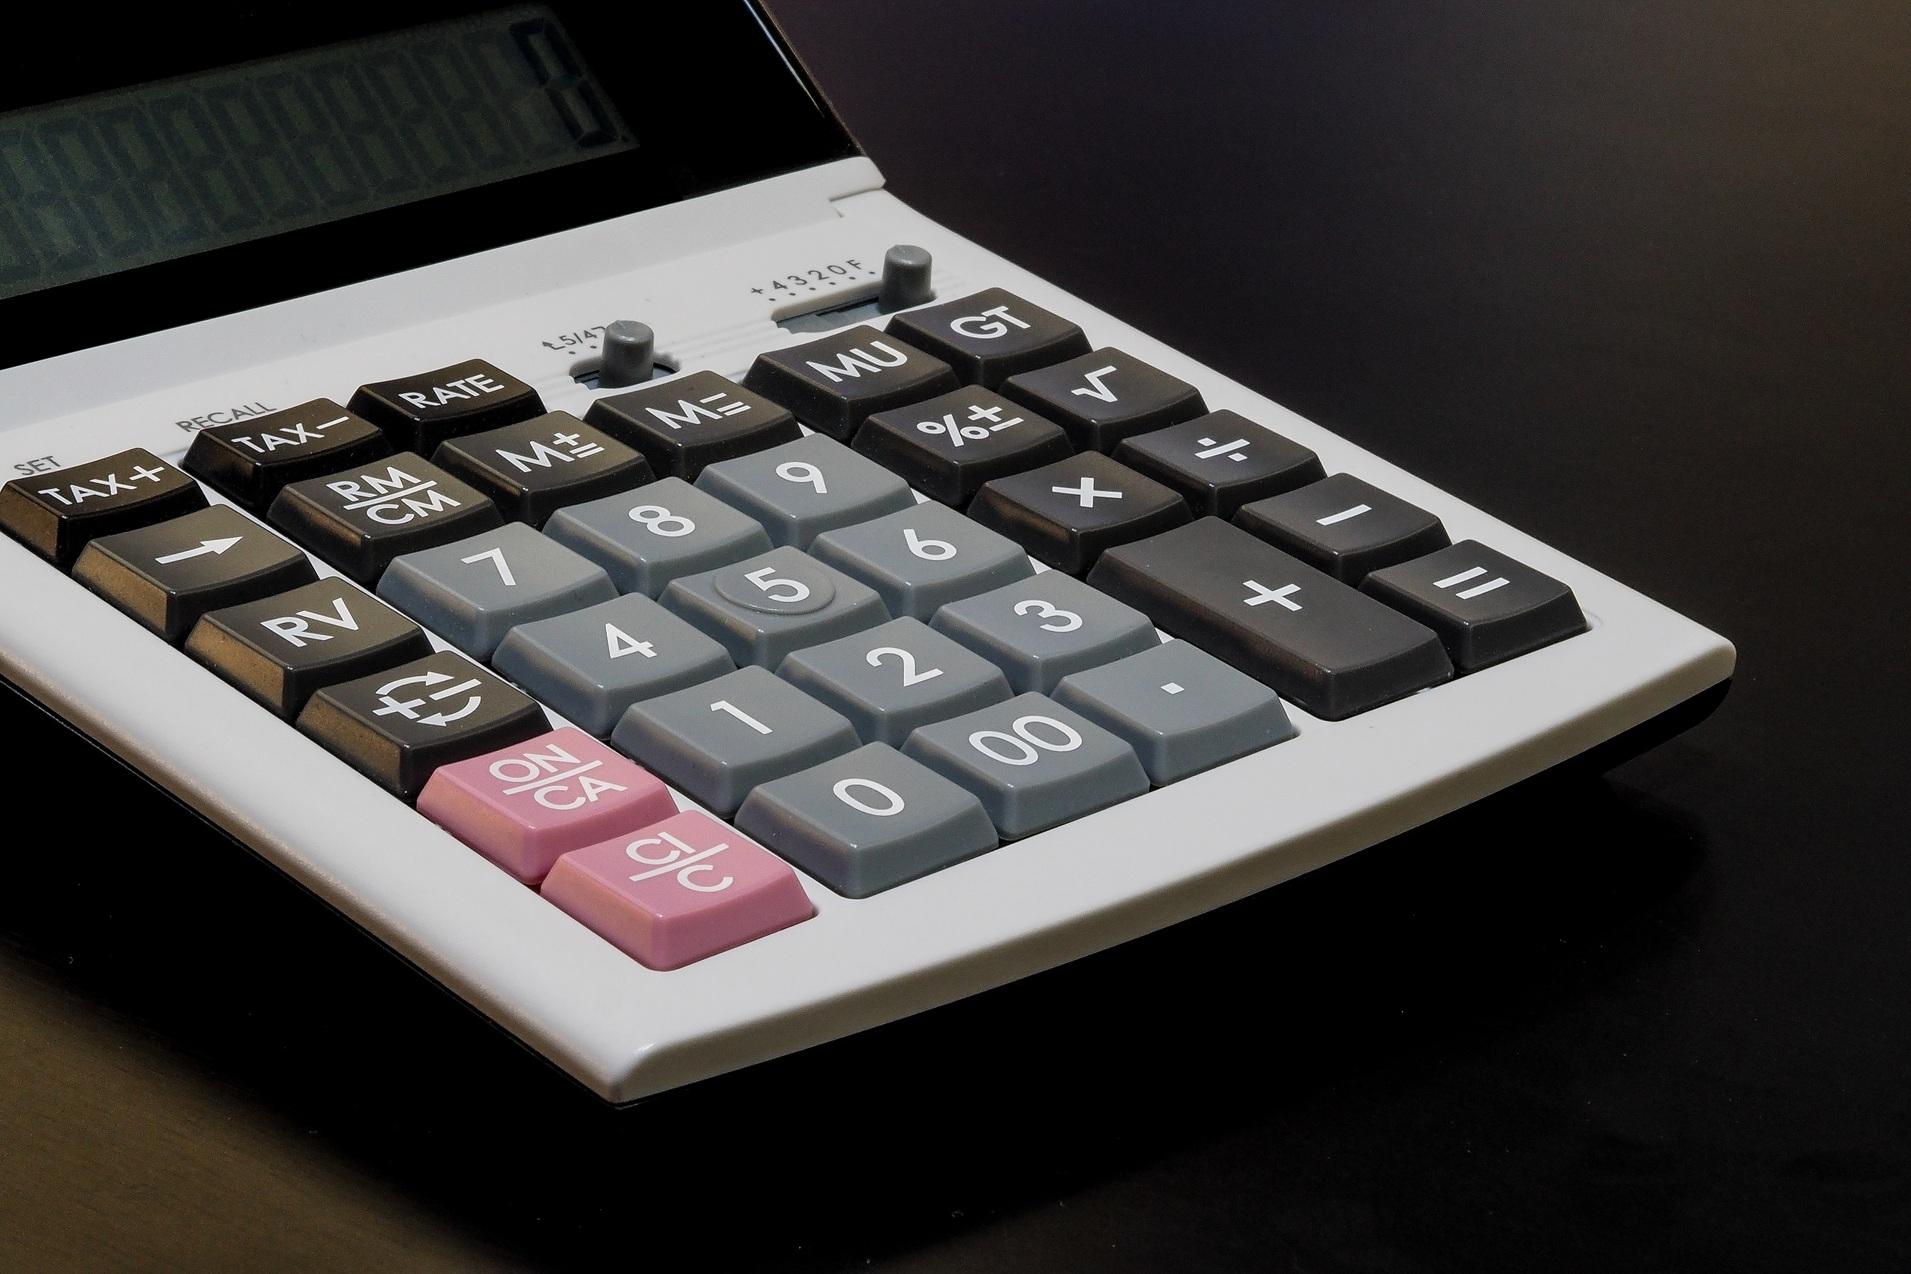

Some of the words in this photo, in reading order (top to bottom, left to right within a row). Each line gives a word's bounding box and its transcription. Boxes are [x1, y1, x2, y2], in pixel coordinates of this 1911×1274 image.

[950, 306, 1031, 339] GT
[806, 340, 907, 383] MU
[398, 373, 504, 409] RATE
[175, 401, 278, 433] RECALL
[14, 455, 62, 476] SET
[325, 464, 424, 503] RM
[776, 462, 827, 493] 9
[38, 464, 165, 507] TAX+
[365, 490, 464, 526] CM
[629, 506, 695, 536] 8
[904, 529, 956, 560] 6
[461, 548, 516, 585] 7
[745, 567, 809, 602] 5
[260, 597, 359, 648] RV
[1014, 600, 1082, 632] 3
[606, 623, 656, 658] 4
[867, 648, 943, 686] 2
[711, 701, 772, 734] 1
[969, 716, 1082, 765] 00
[488, 744, 582, 788] ON
[533, 775, 630, 812] CA
[833, 779, 904, 816] 0
[677, 863, 735, 894] C
